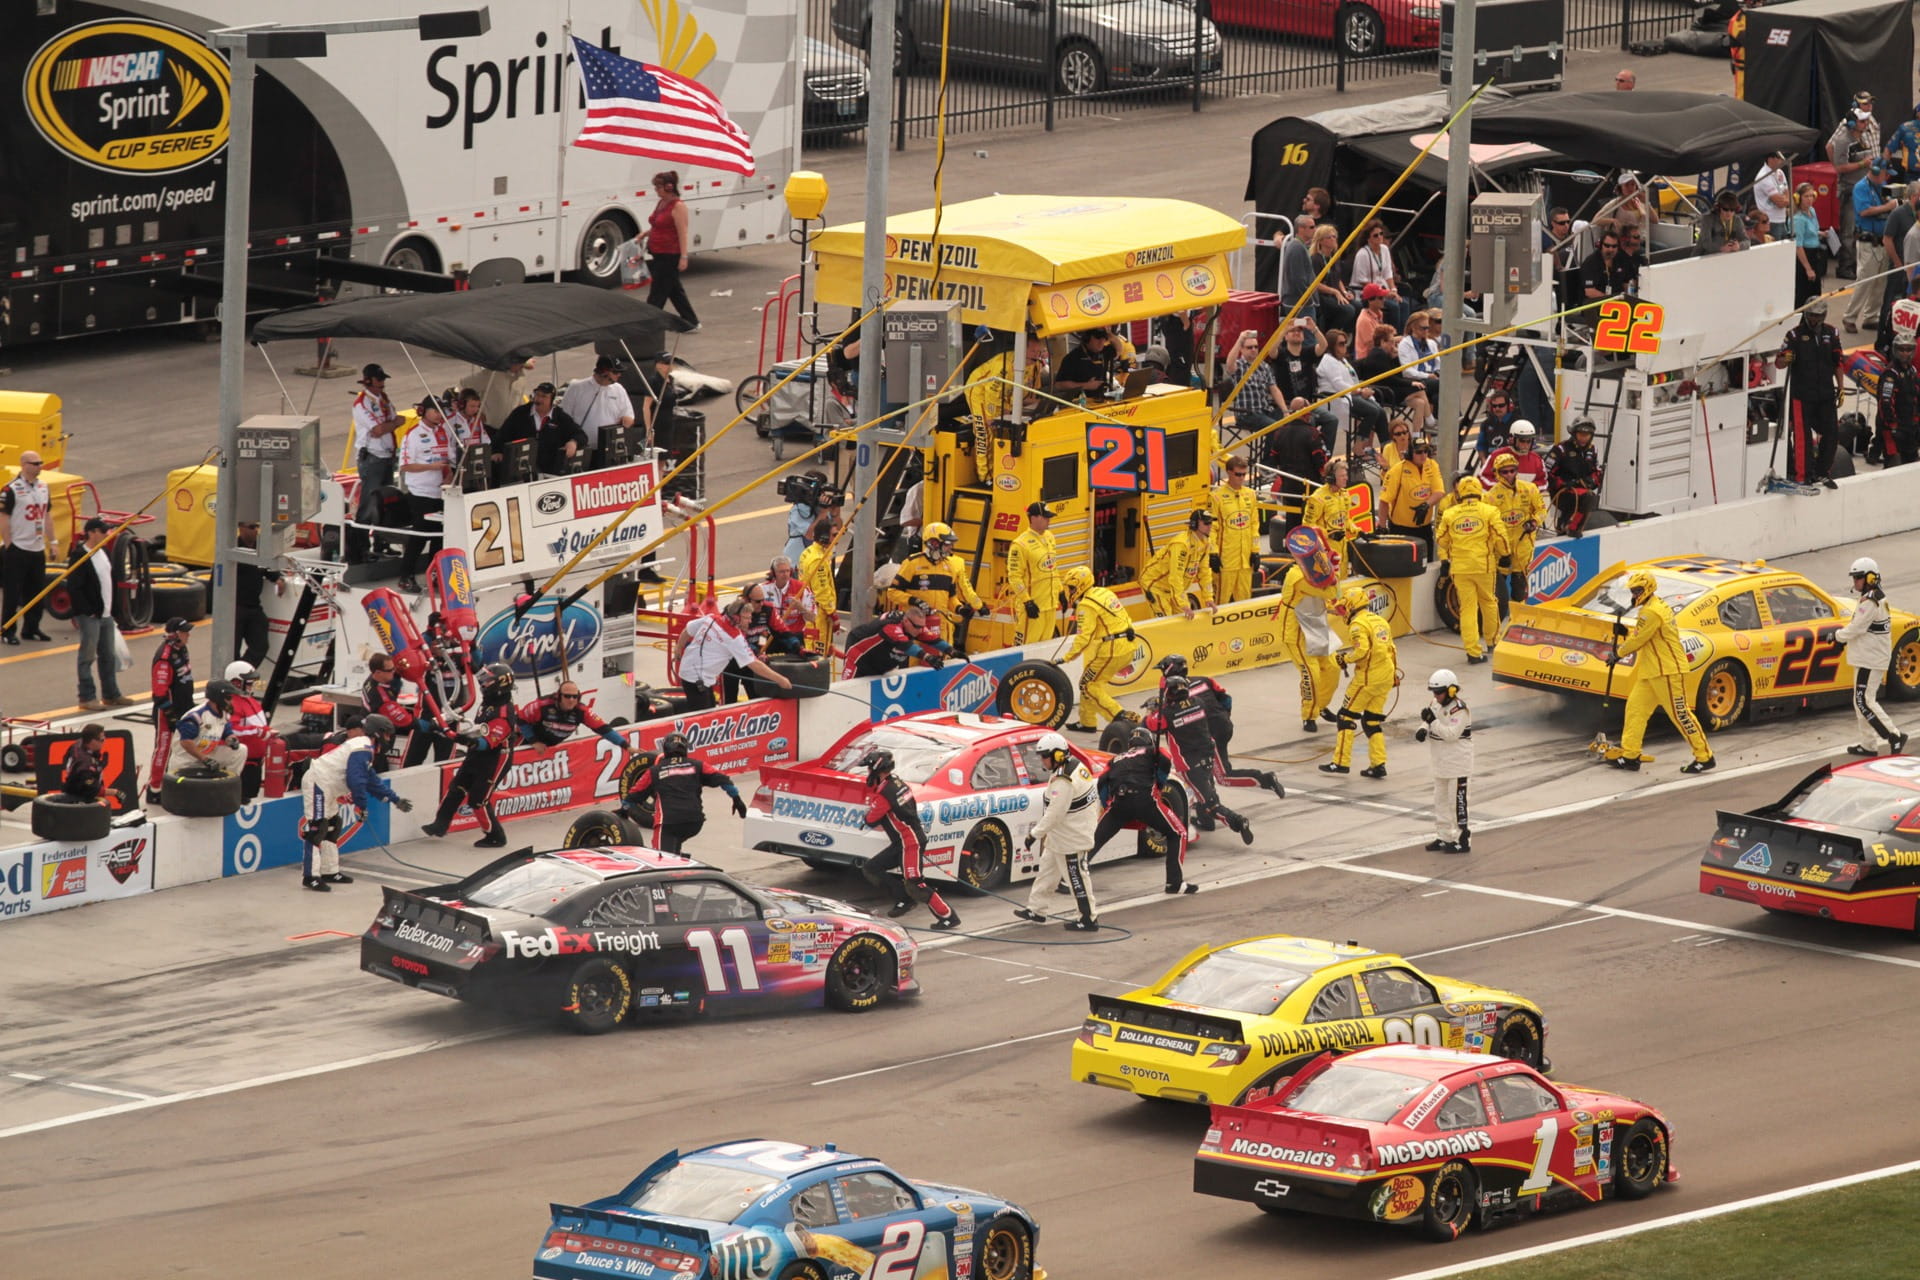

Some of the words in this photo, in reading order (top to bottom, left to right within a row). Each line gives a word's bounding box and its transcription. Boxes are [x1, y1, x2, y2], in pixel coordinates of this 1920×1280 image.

[1767, 28, 1791, 46] 56
[88, 50, 160, 86] NASCAR
[98, 86, 170, 130] Sprint
[106, 143, 146, 160] CUP
[148, 134, 215, 155] SERIES
[1281, 142, 1308, 166] 16
[71, 180, 216, 222] sprint.com/speed
[1136, 245, 1174, 265] PENNZOIL
[1123, 281, 1143, 304] 22
[1595, 301, 1664, 353] 22
[1893, 308, 1918, 330] 3M
[975, 415, 987, 455] PENNZOIL
[1088, 423, 1168, 494] 21
[541, 495, 563, 511] Ford
[575, 474, 650, 511] Motorcraft
[471, 496, 525, 570] 21
[612, 523, 647, 543] Lane
[994, 512, 1020, 532] 22
[1456, 520, 1480, 530] PENNZOIL
[452, 559, 470, 605] SUNOCO
[1528, 552, 1573, 598] CLOROX
[1212, 606, 1279, 626] DODGE
[368, 608, 396, 653] SUNOCO
[499, 613, 577, 667] Ford
[1774, 624, 1846, 688] 22
[945, 669, 993, 711] CLOROX
[1009, 669, 1036, 687] EAGLE
[1524, 669, 1591, 688] CHARGER
[1674, 696, 1697, 735] PENNZOIL
[686, 717, 737, 752] Quick
[735, 712, 781, 739] Lane
[736, 741, 758, 751] CENTER
[496, 750, 573, 791] orcraft
[721, 757, 750, 771] BAYNE
[494, 787, 572, 817] FORDPARTS.COM
[772, 797, 867, 831] FORDPARTS.CO
[940, 800, 986, 826] Quick
[989, 794, 1030, 814] Lane
[805, 831, 827, 846] Ford
[940, 831, 964, 842] CENTER
[982, 823, 1009, 865] GOODYEAR
[63, 879, 85, 891] Parts
[66, 870, 84, 880] Auto
[1760, 884, 1796, 898] TOYOTA
[395, 919, 454, 953] fedex.com
[501, 926, 595, 959] FedEx
[594, 928, 660, 956] Freight
[818, 933, 835, 943] 3M
[466, 945, 485, 960] 11
[684, 926, 763, 995] 11
[838, 937, 888, 964] GOODYEAR
[400, 958, 429, 976] TOYOTA
[611, 964, 632, 1023] GOODYEAR
[1484, 1012, 1497, 1024] 3M
[1120, 1029, 1155, 1045] DOLLAR
[1155, 1037, 1194, 1053] GENERAL
[1258, 1026, 1316, 1058] DOLLAR
[1315, 1020, 1374, 1051] GENERAL
[1218, 1047, 1237, 1061] 20
[1132, 1066, 1170, 1082] TOYOTA
[1405, 1086, 1448, 1129] LiftMaster
[1601, 1129, 1613, 1142] 3M
[1231, 1139, 1336, 1168] McDonald's
[1377, 1130, 1493, 1167] McDonald's
[1518, 1117, 1558, 1197] 1
[1351, 1154, 1362, 1169] 1
[1392, 1190, 1409, 1201] Pro
[1393, 1178, 1414, 1190] Bass
[1431, 1162, 1464, 1208] GOODYEAR
[1391, 1199, 1418, 1214] Shops
[870, 1219, 926, 1280] 2
[576, 1252, 624, 1270] Deuce's
[625, 1259, 655, 1276] Wild
[677, 1257, 695, 1270] 2
[957, 1263, 970, 1276] 3M
